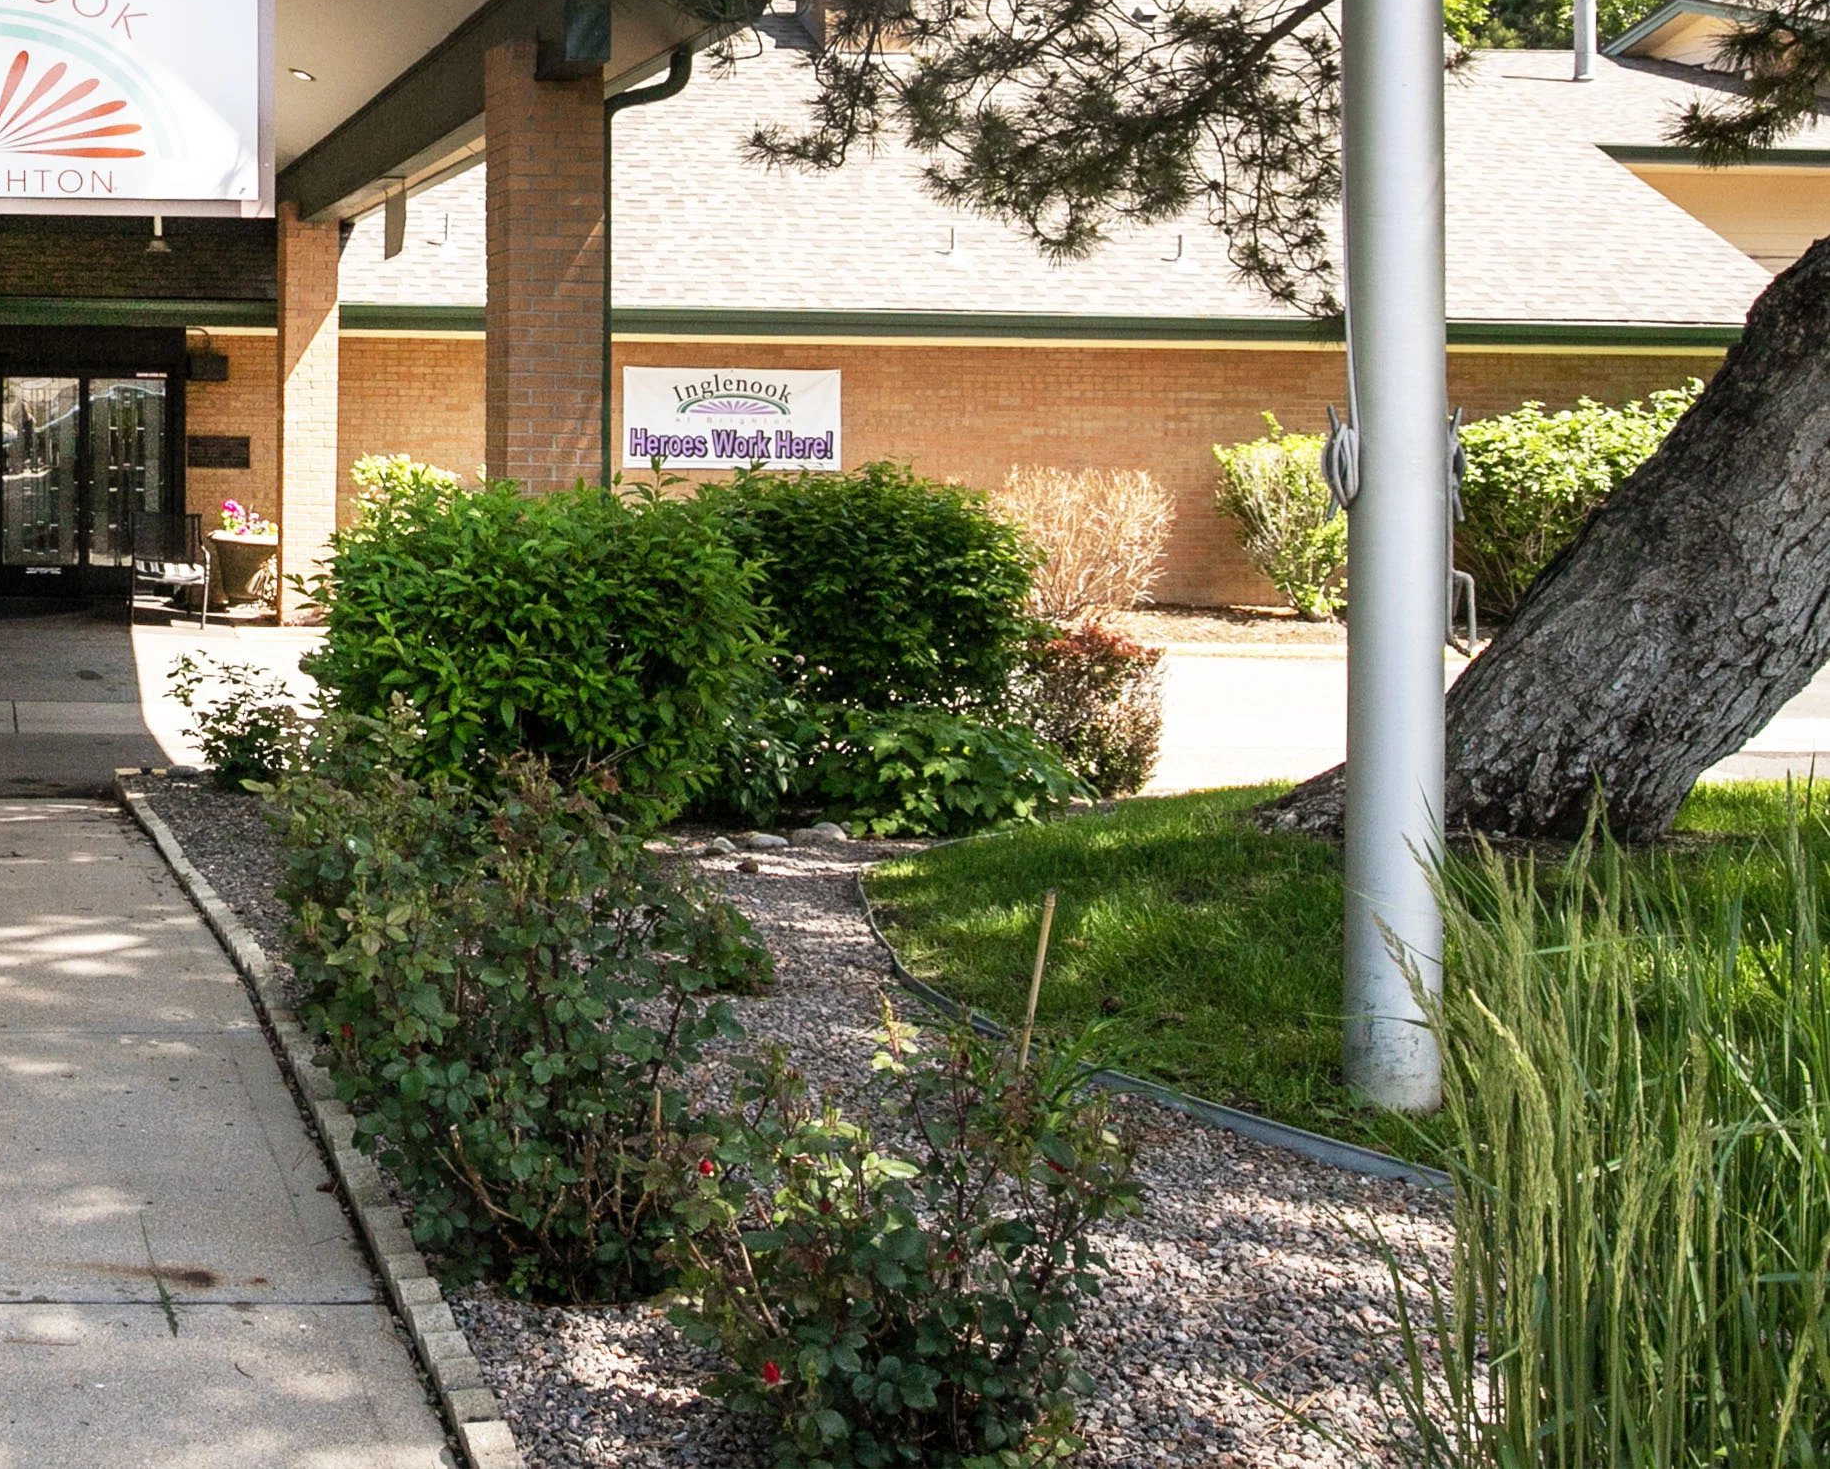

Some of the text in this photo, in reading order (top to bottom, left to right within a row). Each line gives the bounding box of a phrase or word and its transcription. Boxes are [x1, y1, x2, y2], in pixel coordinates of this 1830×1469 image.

[671, 373, 793, 404] Inglenook
[629, 428, 834, 459] Heroes Work Here!
